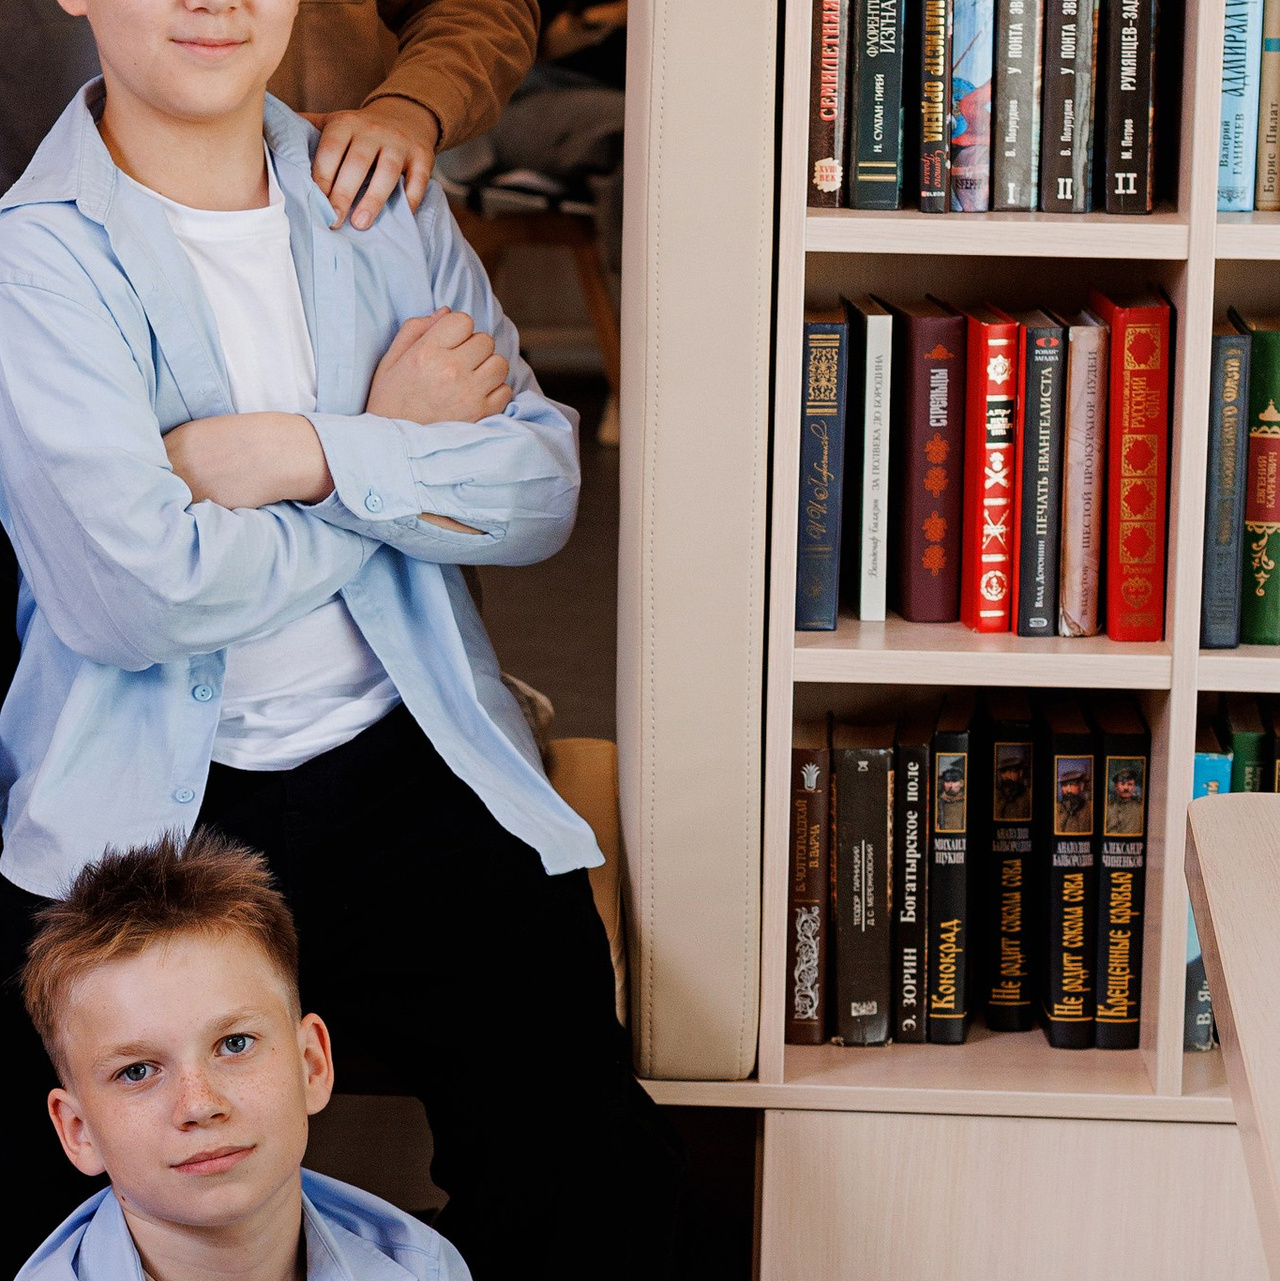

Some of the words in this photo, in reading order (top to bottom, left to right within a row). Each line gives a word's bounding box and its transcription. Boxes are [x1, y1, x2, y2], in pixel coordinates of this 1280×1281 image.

[820, 0, 841, 122] СЕМИЛЕТНЯЯ
[924, 0, 945, 77] МАГИСТР
[1008, 23, 1023, 59] ПОНТА
[1061, 23, 1076, 59] ПОНТА
[1008, 66, 1022, 75] У
[1061, 67, 1075, 75] У
[923, 80, 944, 143] ОРДЕНА
[1122, 118, 1133, 148] Петров
[1266, 102, 1279, 147] Пилат
[873, 143, 882, 153] Н.
[1219, 120, 1230, 168] Валерий
[1233, 113, 1244, 176] ГАНИЧЕВ
[1263, 156, 1275, 195] Борис
[873, 354, 884, 414] БОРОДИНА
[1087, 350, 1098, 396] ИУДЕИ
[874, 416, 883, 429] ДО
[929, 368, 949, 428] СТРЕЛЬЦЫ
[1038, 367, 1053, 472] ЕВАНГЕЛИСТА
[1131, 376, 1148, 429] РУССКИЙ
[872, 432, 882, 478] ПОЛВЕКА
[1083, 401, 1096, 486] ПРОКУРАТОР
[871, 480, 880, 491] ЗА
[1256, 455, 1267, 505] ЕВГЕНИЙ
[1266, 451, 1278, 509] КАРНОВИЧ
[1036, 475, 1050, 536] ПЕЧАТЬ
[1081, 496, 1093, 549] ШЕСТОЙ
[907, 761, 919, 802] поле
[901, 810, 921, 924] Богатырское
[853, 894, 861, 926] ТЕОДОР
[903, 947, 918, 1008] ЗОРИН
[932, 919, 962, 1010] Конокрад
[902, 1014, 917, 1032] Э.
